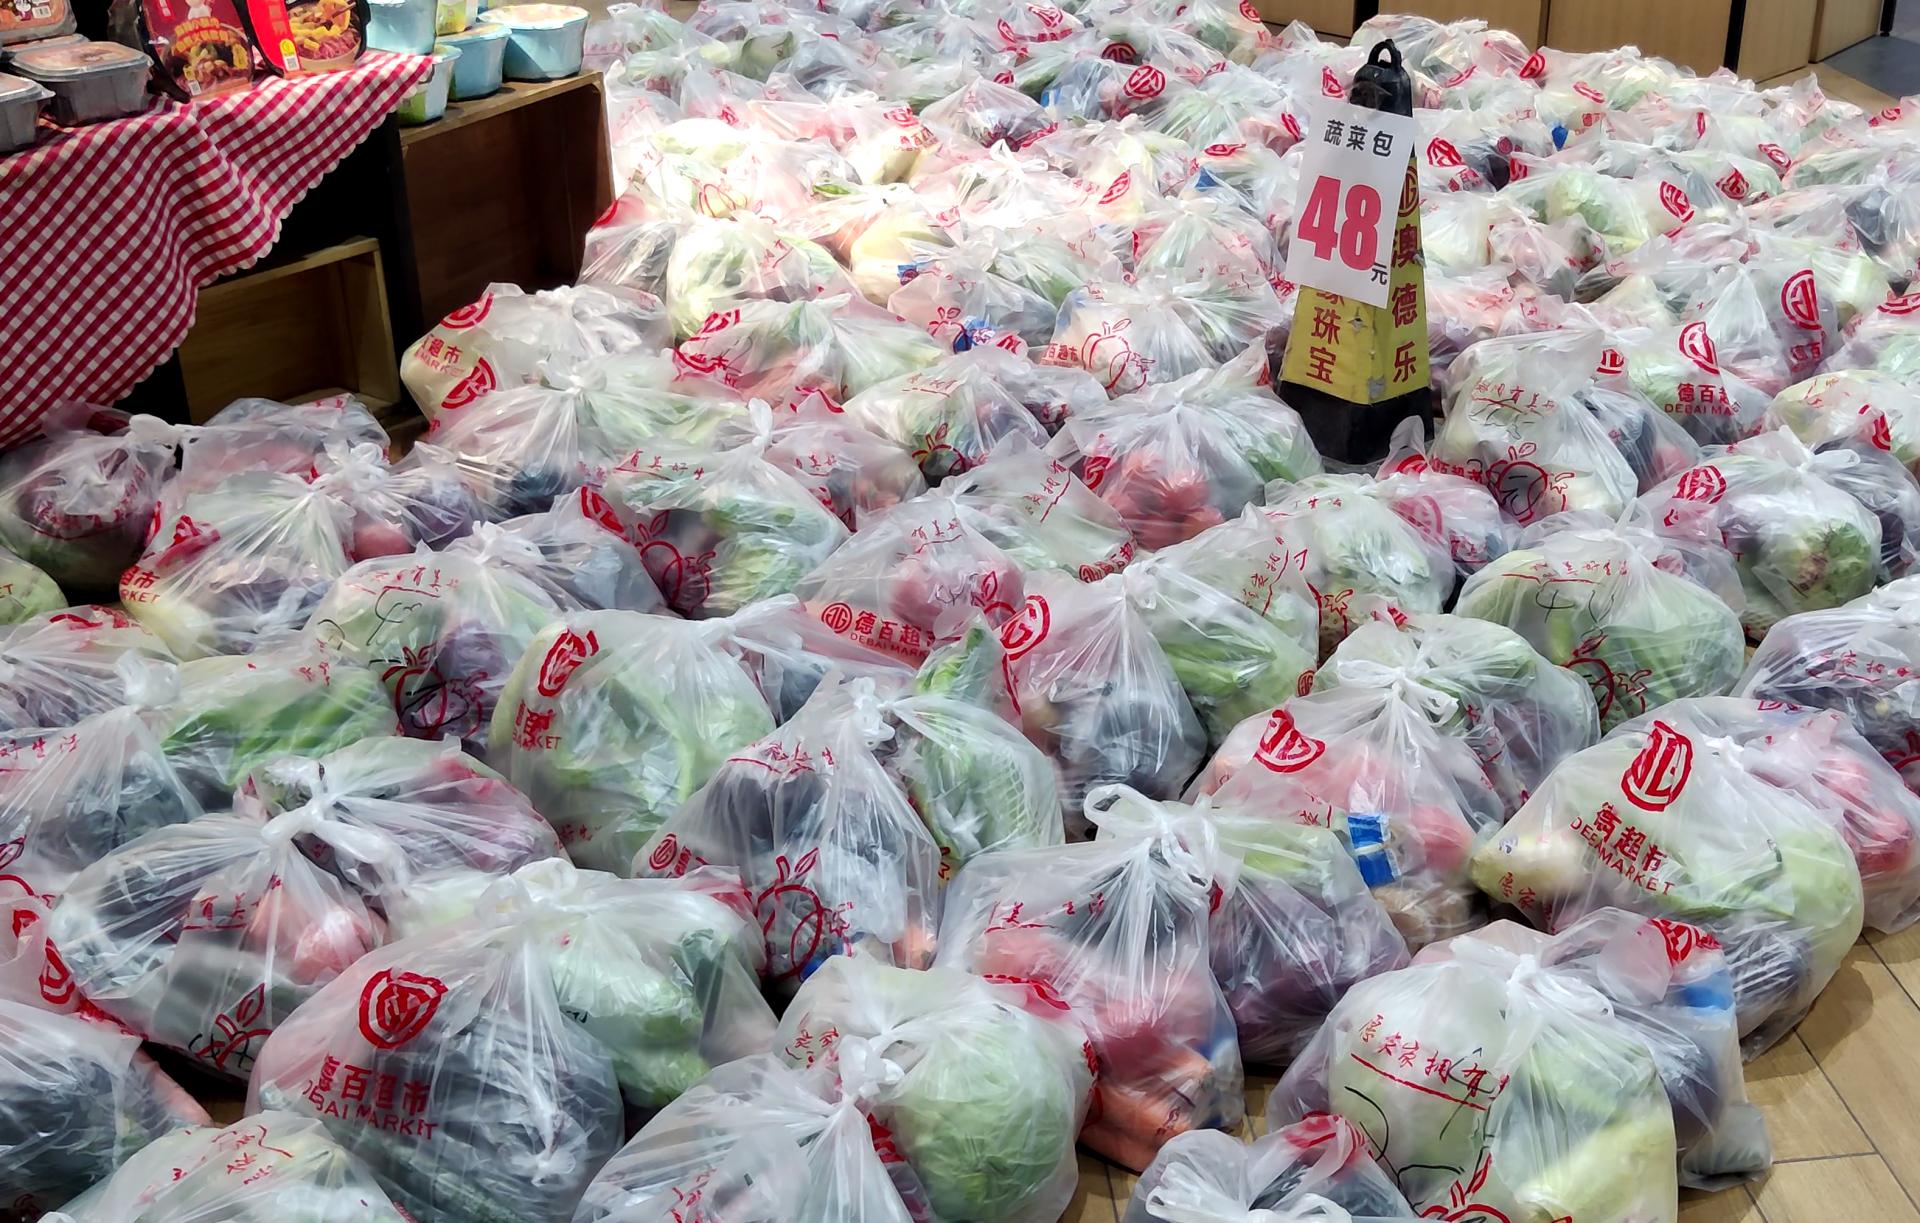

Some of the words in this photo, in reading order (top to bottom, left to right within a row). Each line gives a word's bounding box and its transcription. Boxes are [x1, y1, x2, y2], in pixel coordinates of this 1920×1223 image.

[1323, 119, 1394, 157] 蔬菜包
[1297, 175, 1382, 271] 48
[1371, 262, 1388, 285] 元
[1391, 223, 1419, 383] 澳德乐
